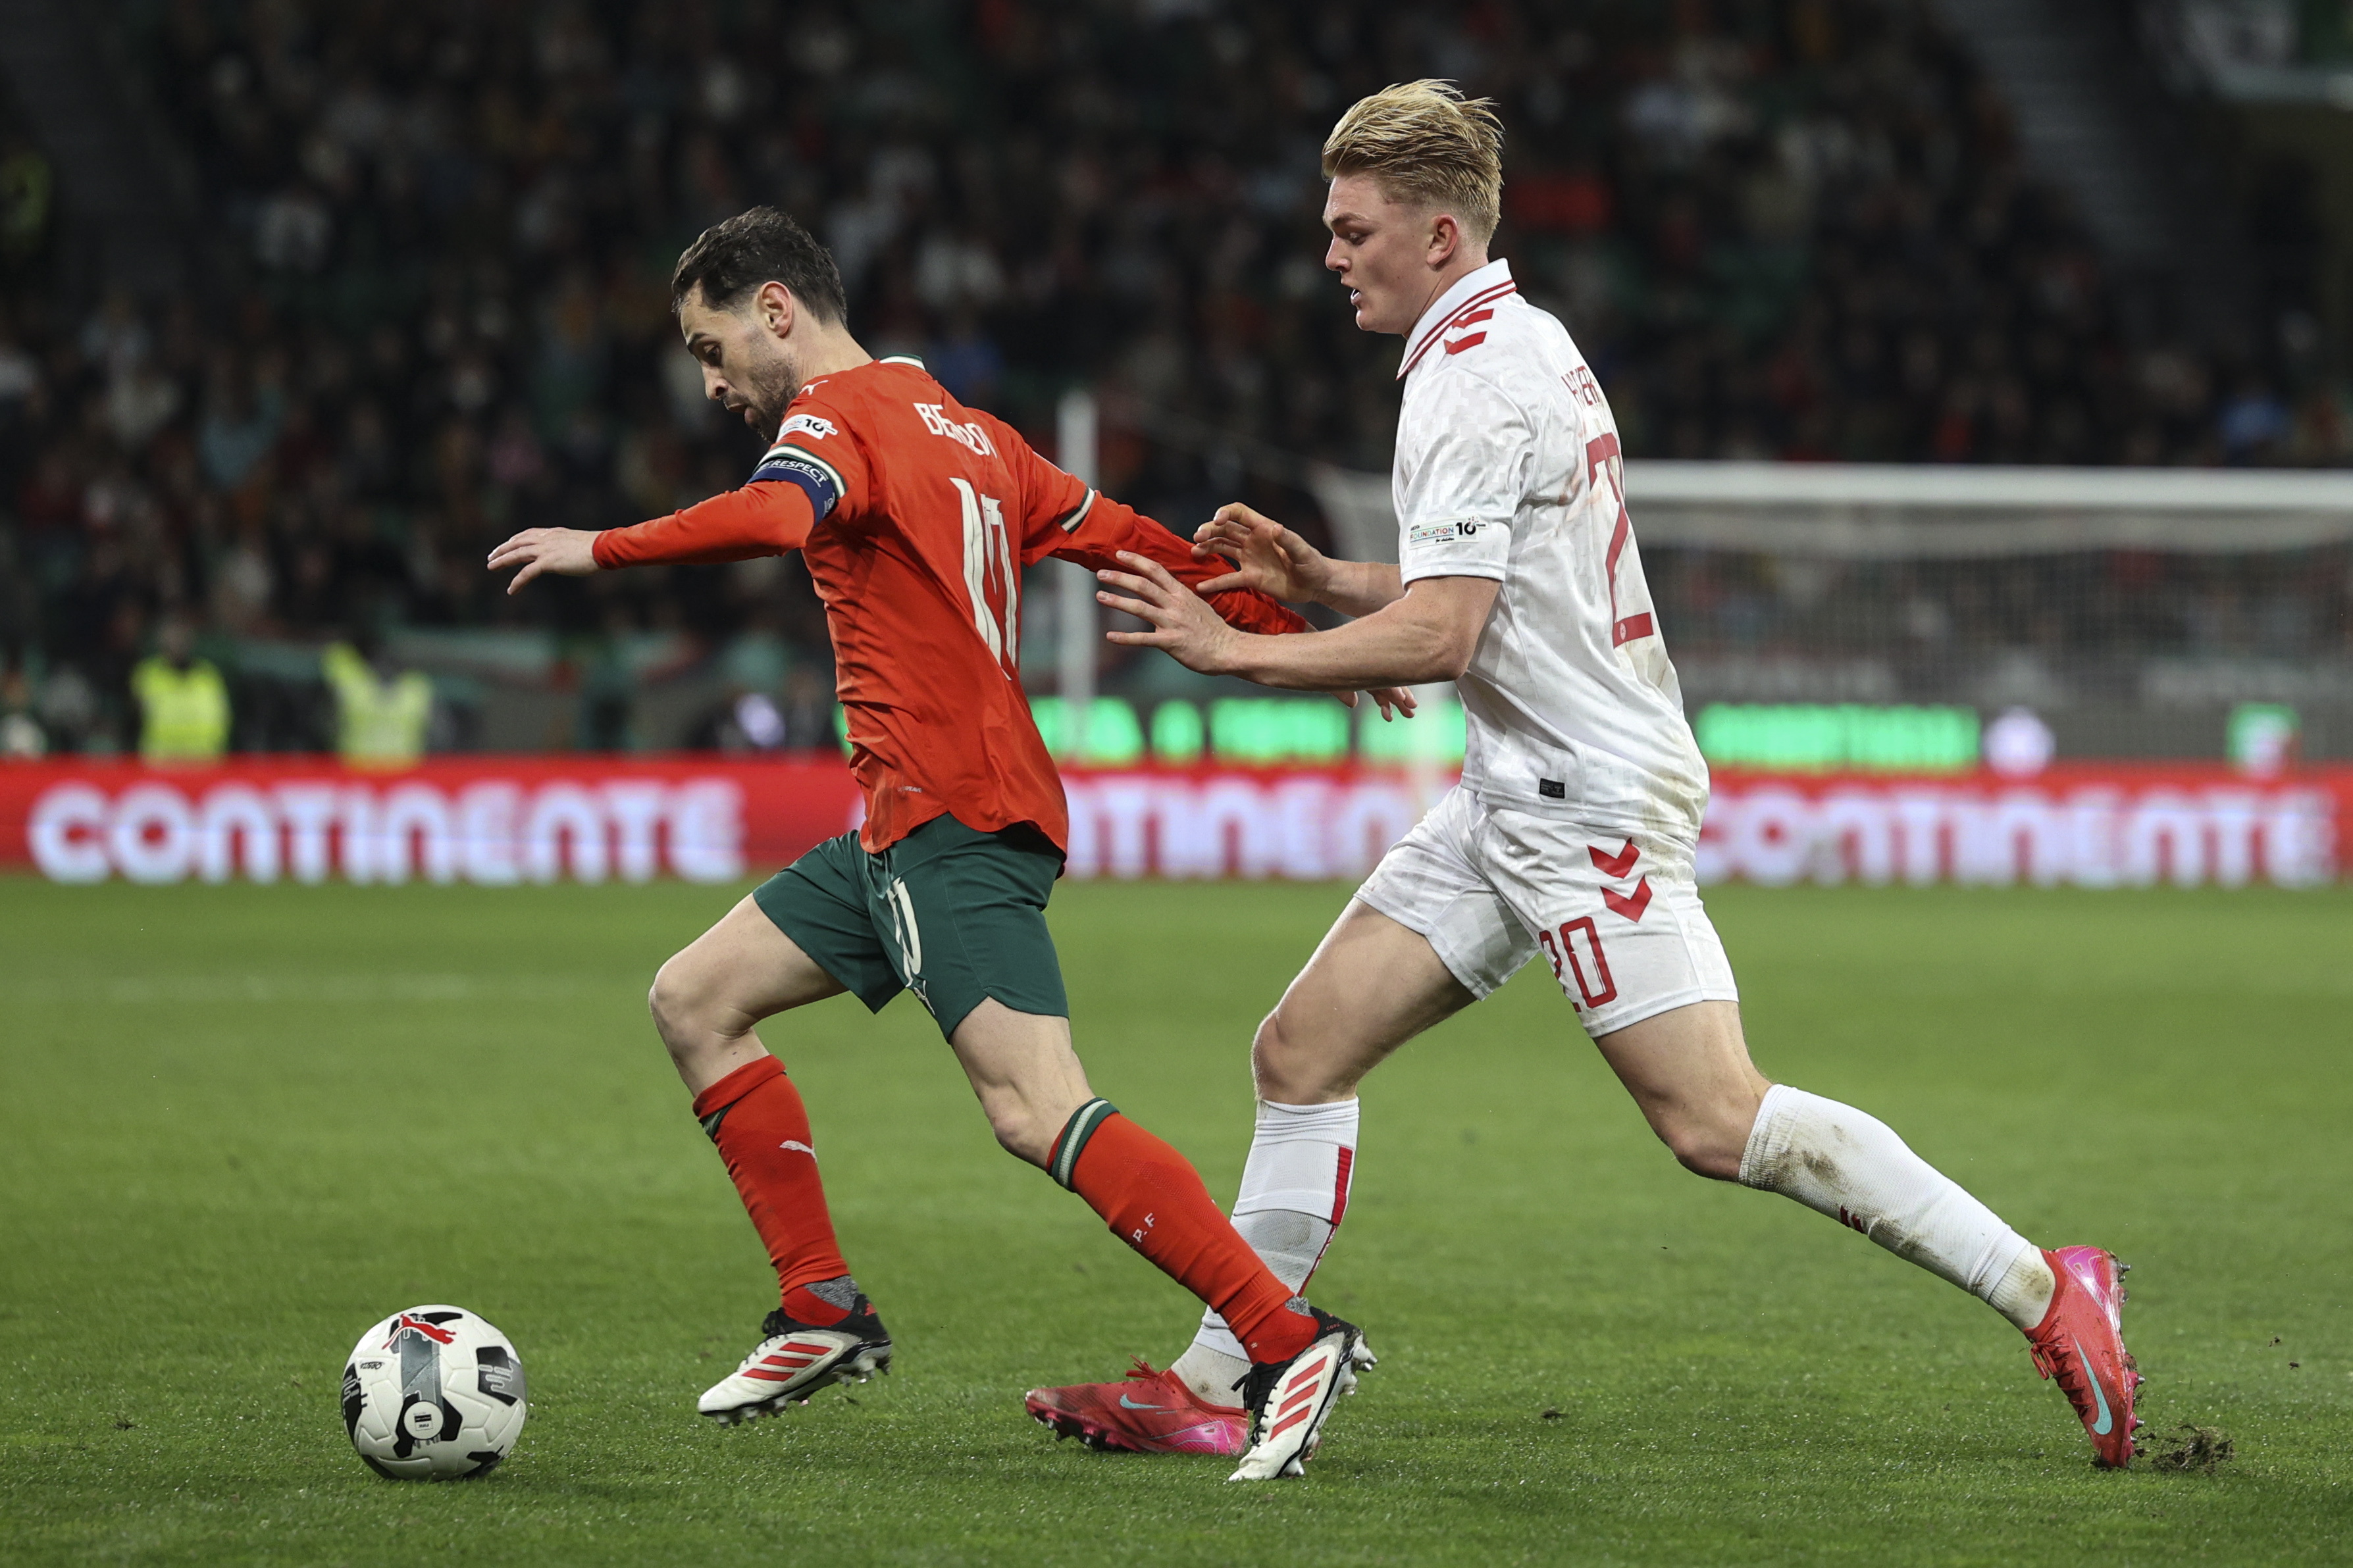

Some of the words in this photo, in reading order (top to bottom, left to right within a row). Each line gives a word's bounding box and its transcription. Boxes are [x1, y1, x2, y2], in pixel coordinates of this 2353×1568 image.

[805, 418, 825, 432] 10
[771, 460, 827, 482] RESPECT
[1410, 527, 1454, 540] FOUNDATION
[1455, 522, 1476, 536] 10
[29, 782, 745, 884] CONTINENTE
